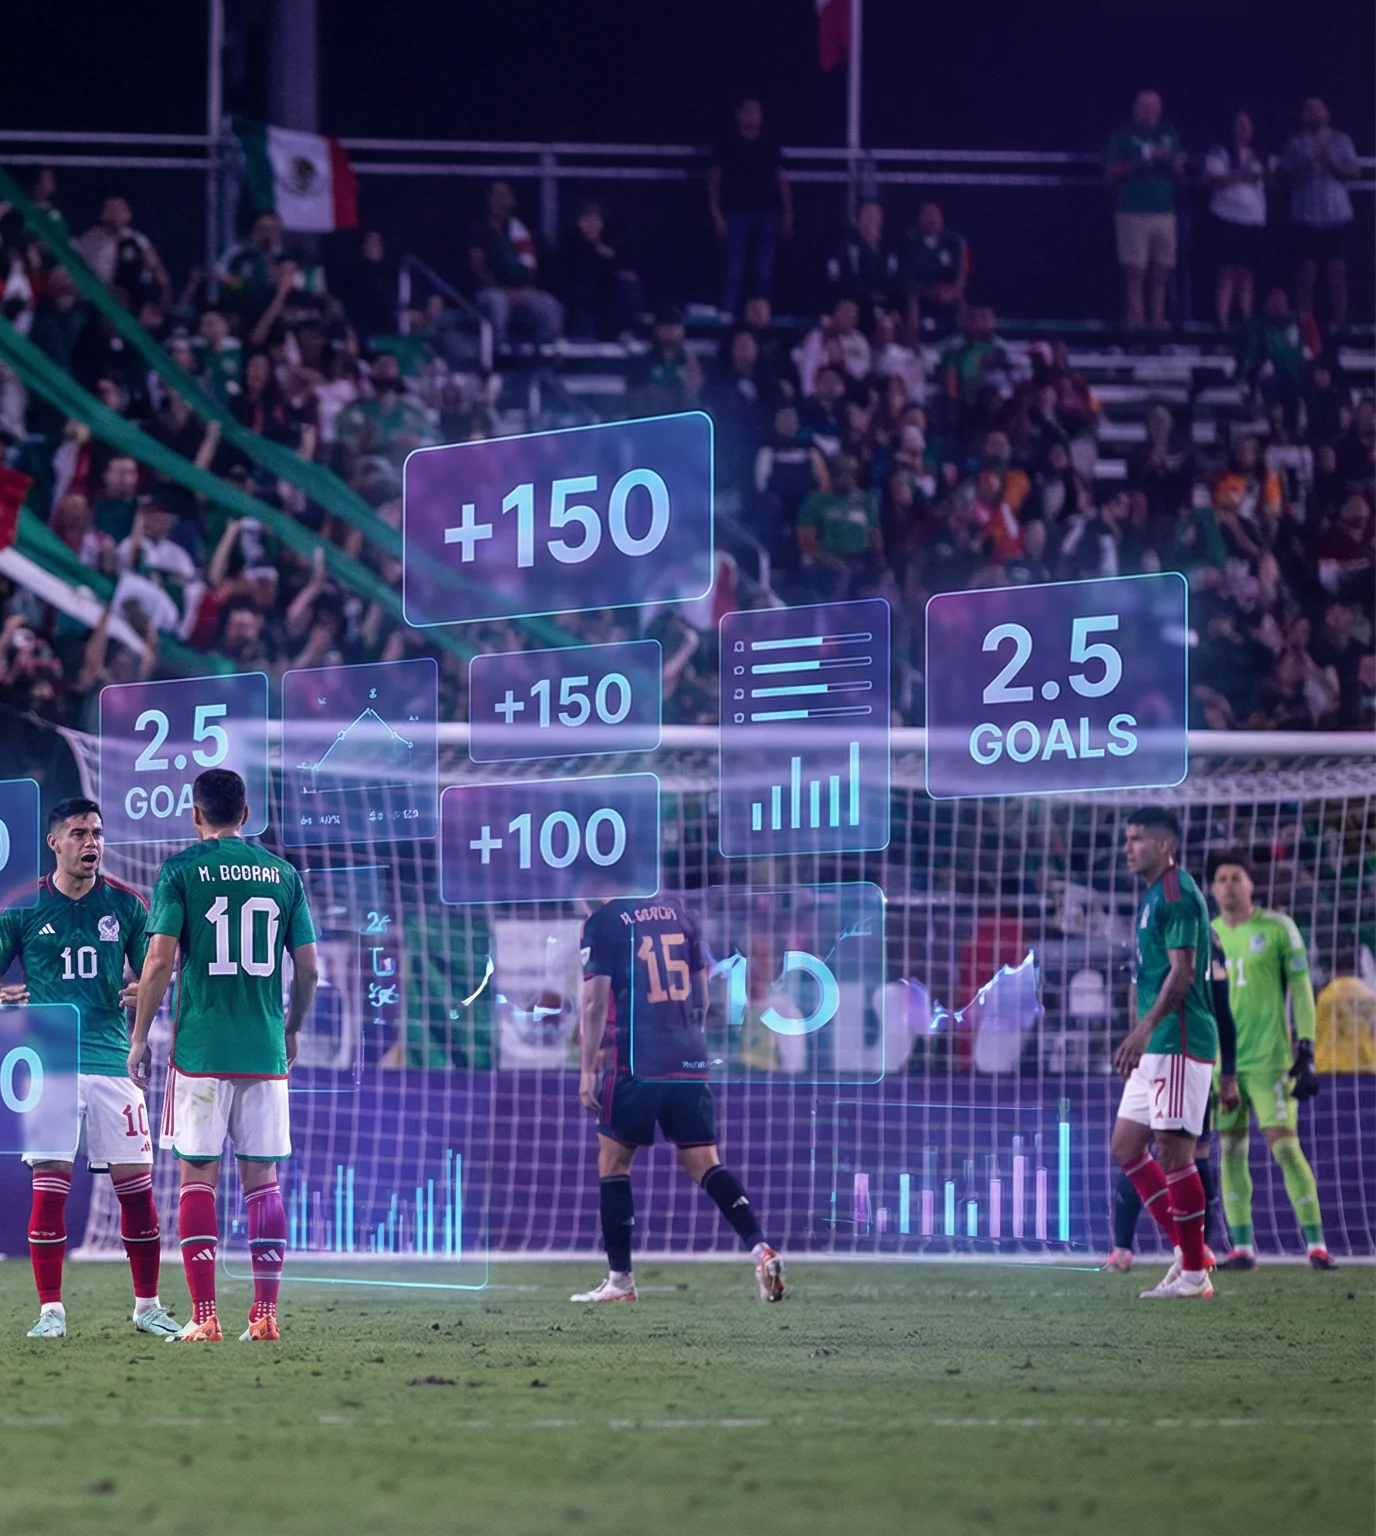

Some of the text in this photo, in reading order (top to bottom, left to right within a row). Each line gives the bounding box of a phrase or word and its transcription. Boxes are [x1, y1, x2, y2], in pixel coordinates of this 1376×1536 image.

[60, 945, 98, 980] 10
[204, 896, 281, 977] 10
[638, 933, 690, 1004] 15
[1153, 1077, 1168, 1107] 7
